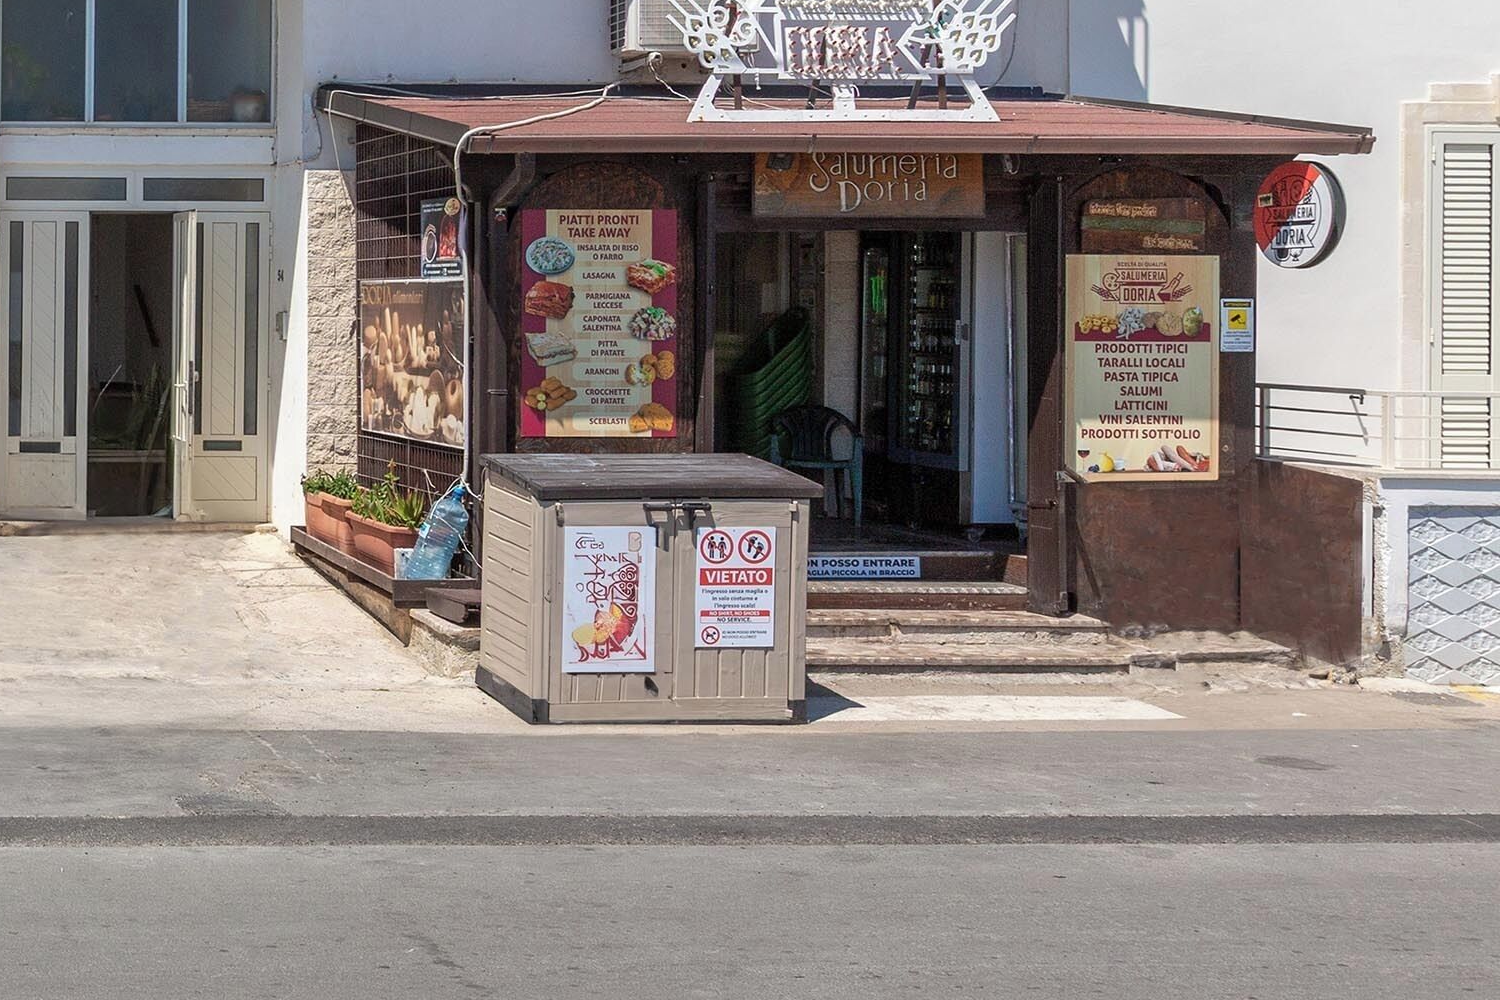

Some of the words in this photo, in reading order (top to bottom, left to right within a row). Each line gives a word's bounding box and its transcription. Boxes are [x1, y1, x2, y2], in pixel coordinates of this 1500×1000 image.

[808, 151, 957, 192] Salumeria
[836, 179, 927, 212] Doria
[560, 215, 595, 225] PIATTI
[597, 215, 639, 225] PRONTI
[568, 228, 596, 238] TAKE
[599, 228, 631, 238] AWAY
[1275, 228, 1306, 246] DORIA
[1120, 271, 1166, 281] SALUMERIA
[1123, 288, 1157, 301] DORIA
[1095, 343, 1153, 354] PRODOTTI
[1156, 343, 1188, 354] TIPICI
[1097, 358, 1143, 368] TARALLI
[1146, 358, 1185, 368] LOCALI
[1104, 372, 1139, 382] PASTA
[1142, 372, 1179, 382] TIPICA
[1120, 386, 1163, 396] SALUMI
[1114, 400, 1168, 411] LATTICINI
[1099, 415, 1123, 425] VINI
[1126, 415, 1183, 425] SALENTINI
[1081, 429, 1139, 439] PRODOTTI
[1141, 429, 1201, 439] SOTT'OLIO
[822, 559, 859, 567] POSSO
[863, 559, 915, 567] ENTRARE
[705, 571, 767, 583] VIETATO
